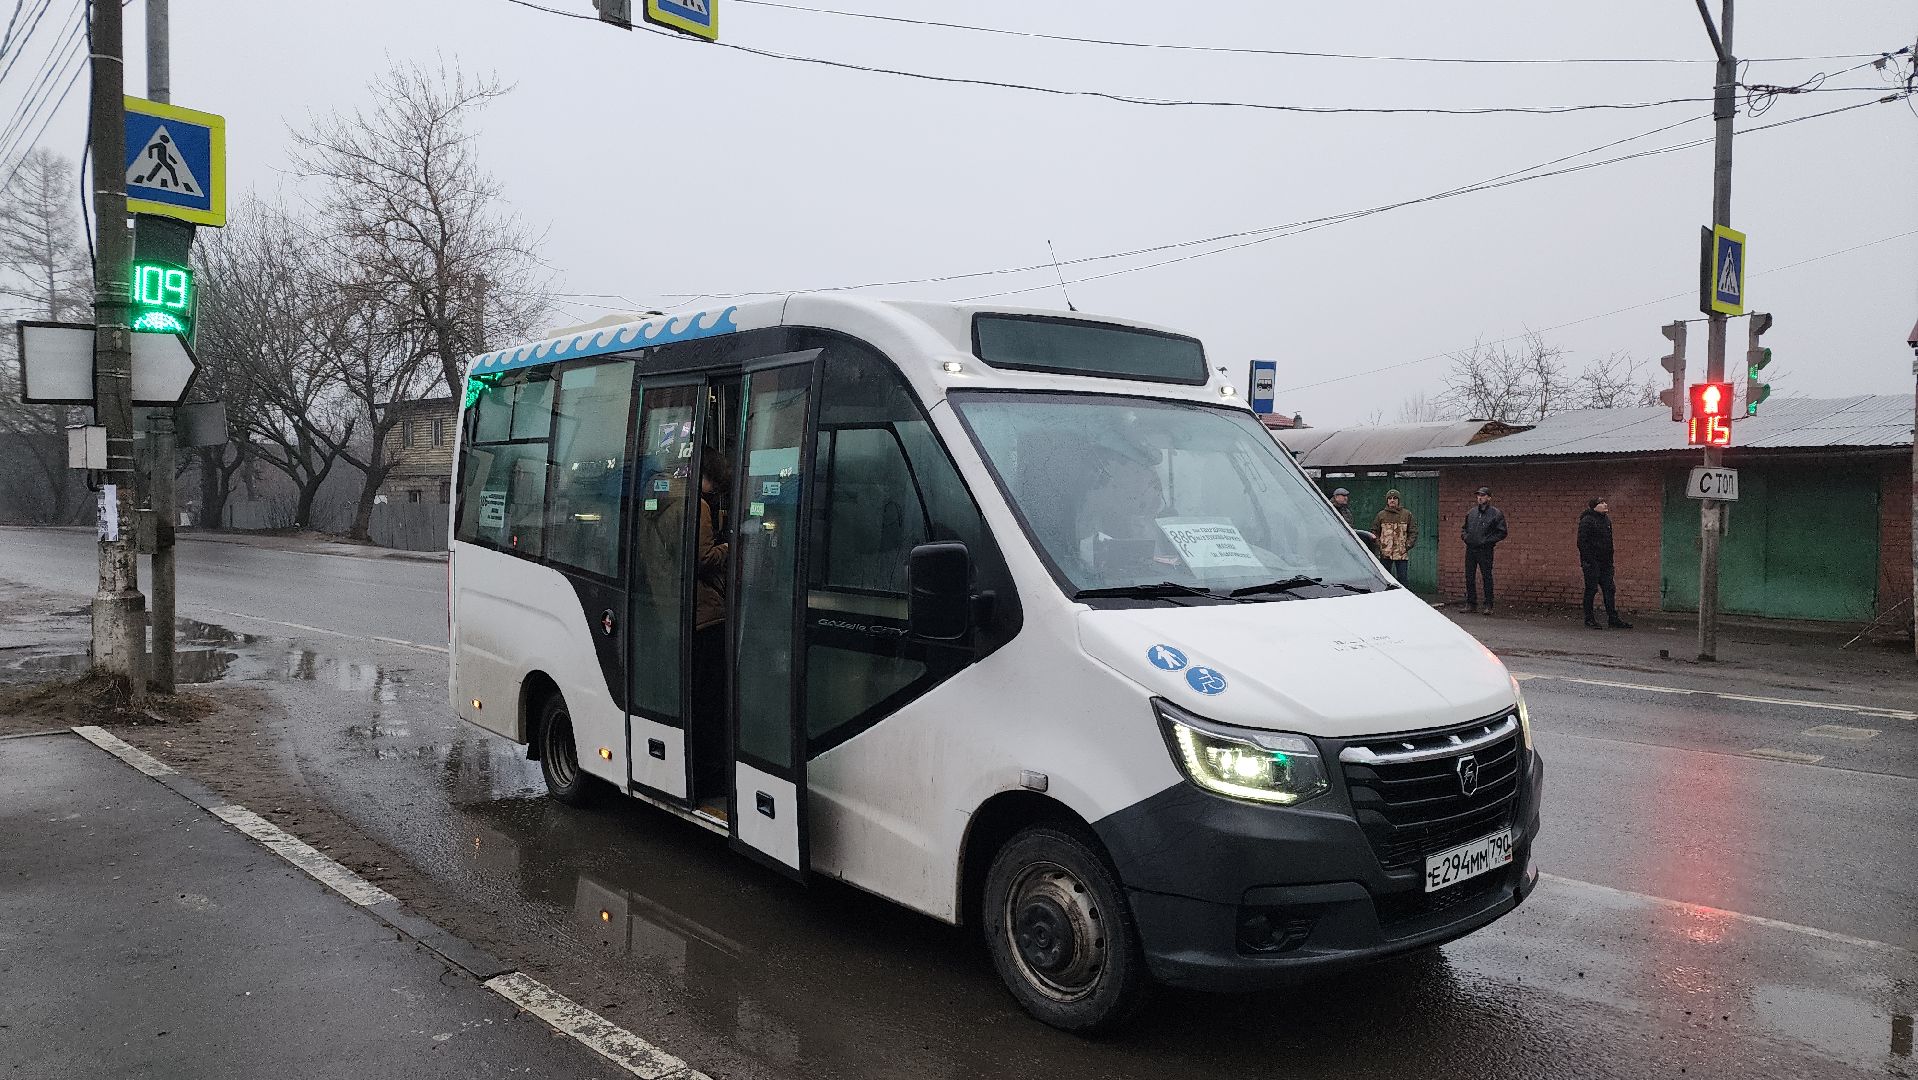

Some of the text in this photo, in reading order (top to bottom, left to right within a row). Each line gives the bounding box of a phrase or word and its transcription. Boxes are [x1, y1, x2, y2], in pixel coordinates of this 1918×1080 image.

[134, 266, 187, 308] 109
[1690, 416, 1729, 444] 115
[1169, 530, 1197, 544] 886
[1490, 833, 1510, 859] 790
